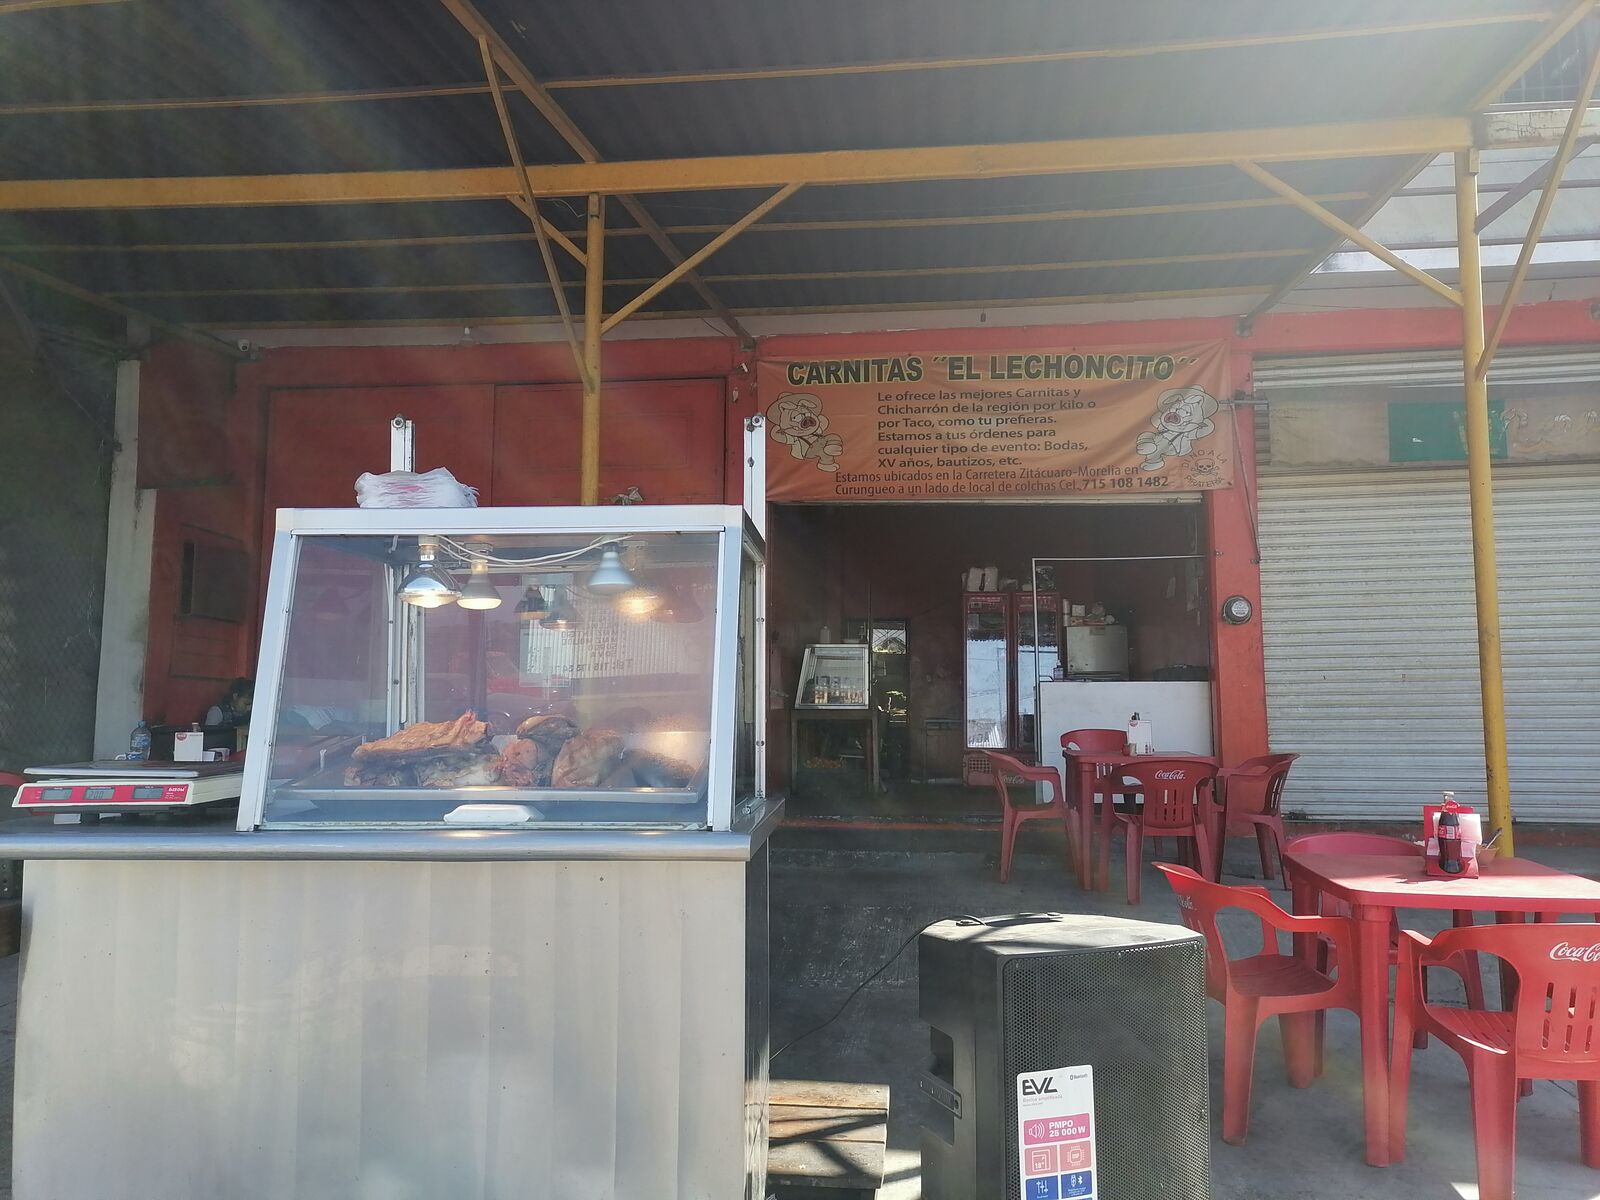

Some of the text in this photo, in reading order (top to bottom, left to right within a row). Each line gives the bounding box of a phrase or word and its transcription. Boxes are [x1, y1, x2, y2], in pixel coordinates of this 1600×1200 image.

[786, 356, 924, 385] CARNITAS
[878, 388, 1081, 402] Le ofrece las mejores Carnitas y
[878, 400, 1096, 415] Chicharrón de la región por kilo o
[878, 414, 1057, 430] por Taco, como tu prefieras.
[878, 429, 1056, 441] Estamos a tus órdenes para
[878, 440, 1088, 456] cualquier tipo de evento: Bodas,
[878, 456, 1022, 469] XV años, bautizos, etc.
[836, 466, 1138, 482] Estamos ubicados en la Carretera Zitácuaro-Morelia en
[836, 484, 895, 496] Curungueo
[898, 486, 904, 494] a
[908, 486, 922, 494] un
[925, 483, 949, 494] lado
[952, 482, 966, 493] de
[969, 482, 997, 493] local
[998, 482, 1012, 492] de
[1014, 480, 1056, 491] colchas
[1082, 479, 1105, 490] 715
[1110, 478, 1134, 488] 108
[1137, 476, 1168, 487] 1482
[1022, 1076, 1058, 1096] EVL
[1049, 1120, 1073, 1130] PMPO
[1049, 1126, 1086, 1137] 25 000 W
